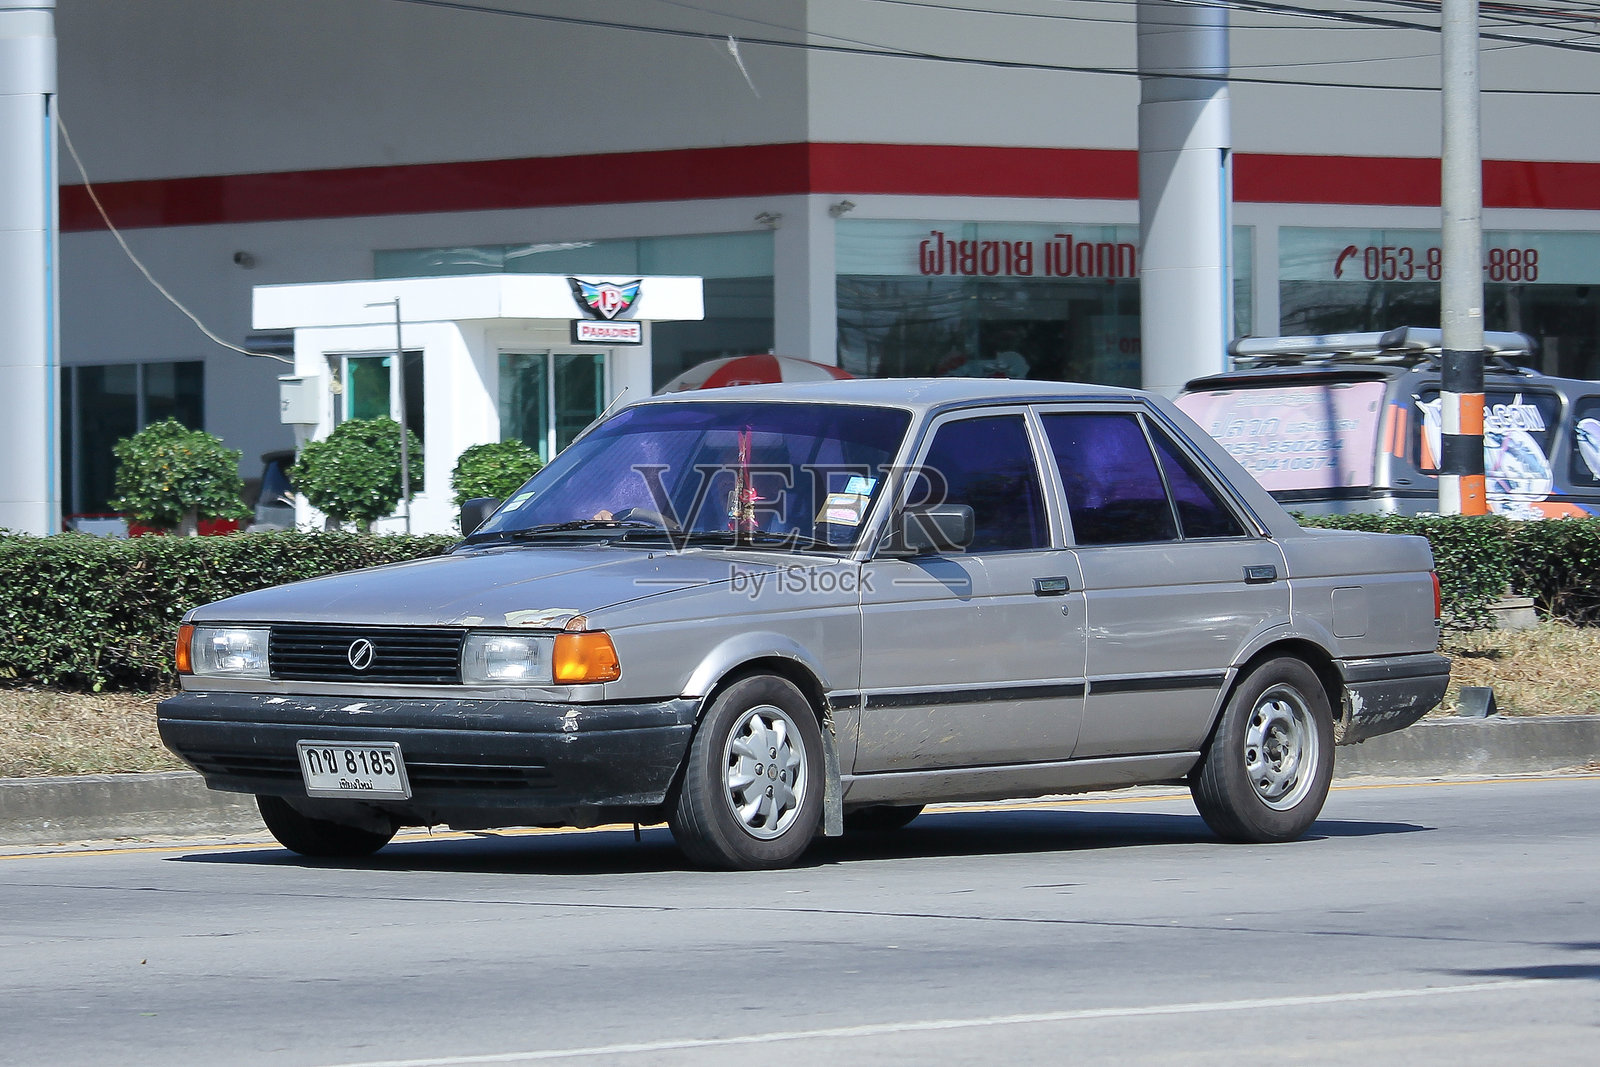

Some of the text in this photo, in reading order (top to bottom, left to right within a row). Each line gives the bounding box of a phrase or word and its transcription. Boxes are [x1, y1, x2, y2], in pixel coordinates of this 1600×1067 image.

[919, 230, 1140, 286] ฝ่ายขาย เปิดทุก
[1363, 246, 1539, 282] 053-8-888
[581, 325, 638, 338] PARADISE
[306, 748, 396, 776] กข 8185
